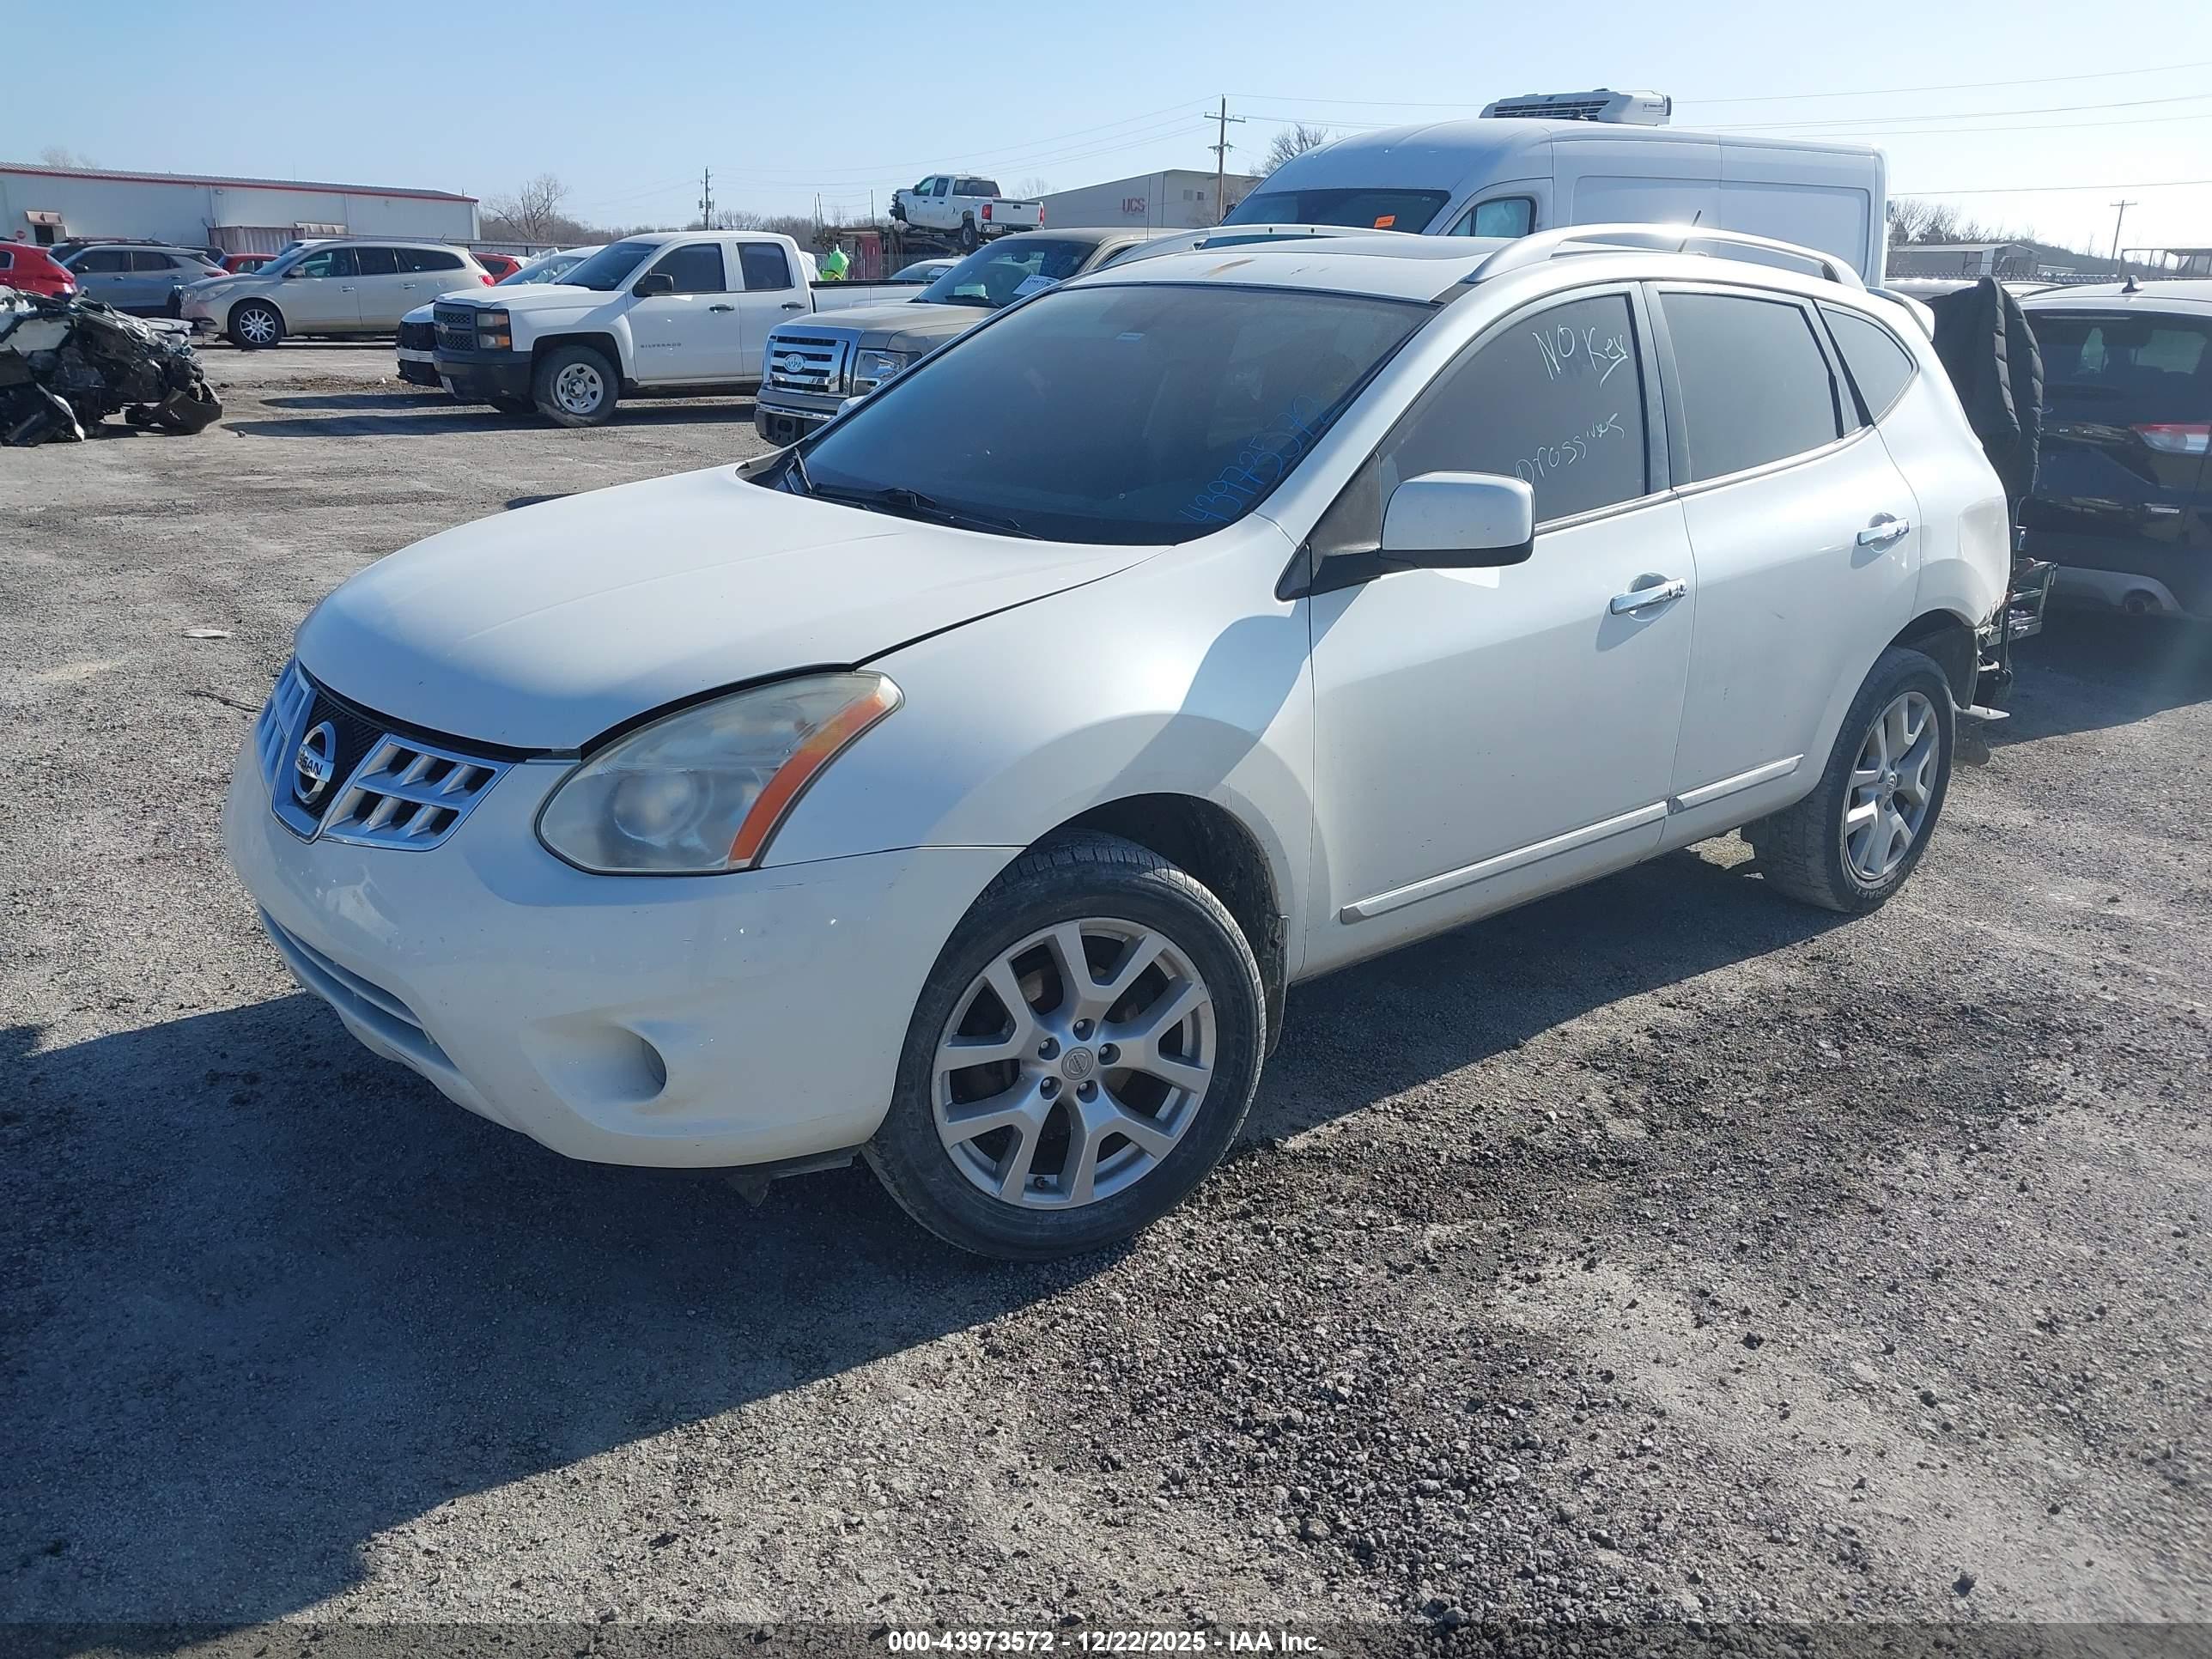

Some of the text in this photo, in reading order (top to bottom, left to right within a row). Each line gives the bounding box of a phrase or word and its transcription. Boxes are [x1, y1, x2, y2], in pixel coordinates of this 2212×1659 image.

[1122, 198, 1146, 213] UCS
[1532, 324, 1628, 388] NO Key
